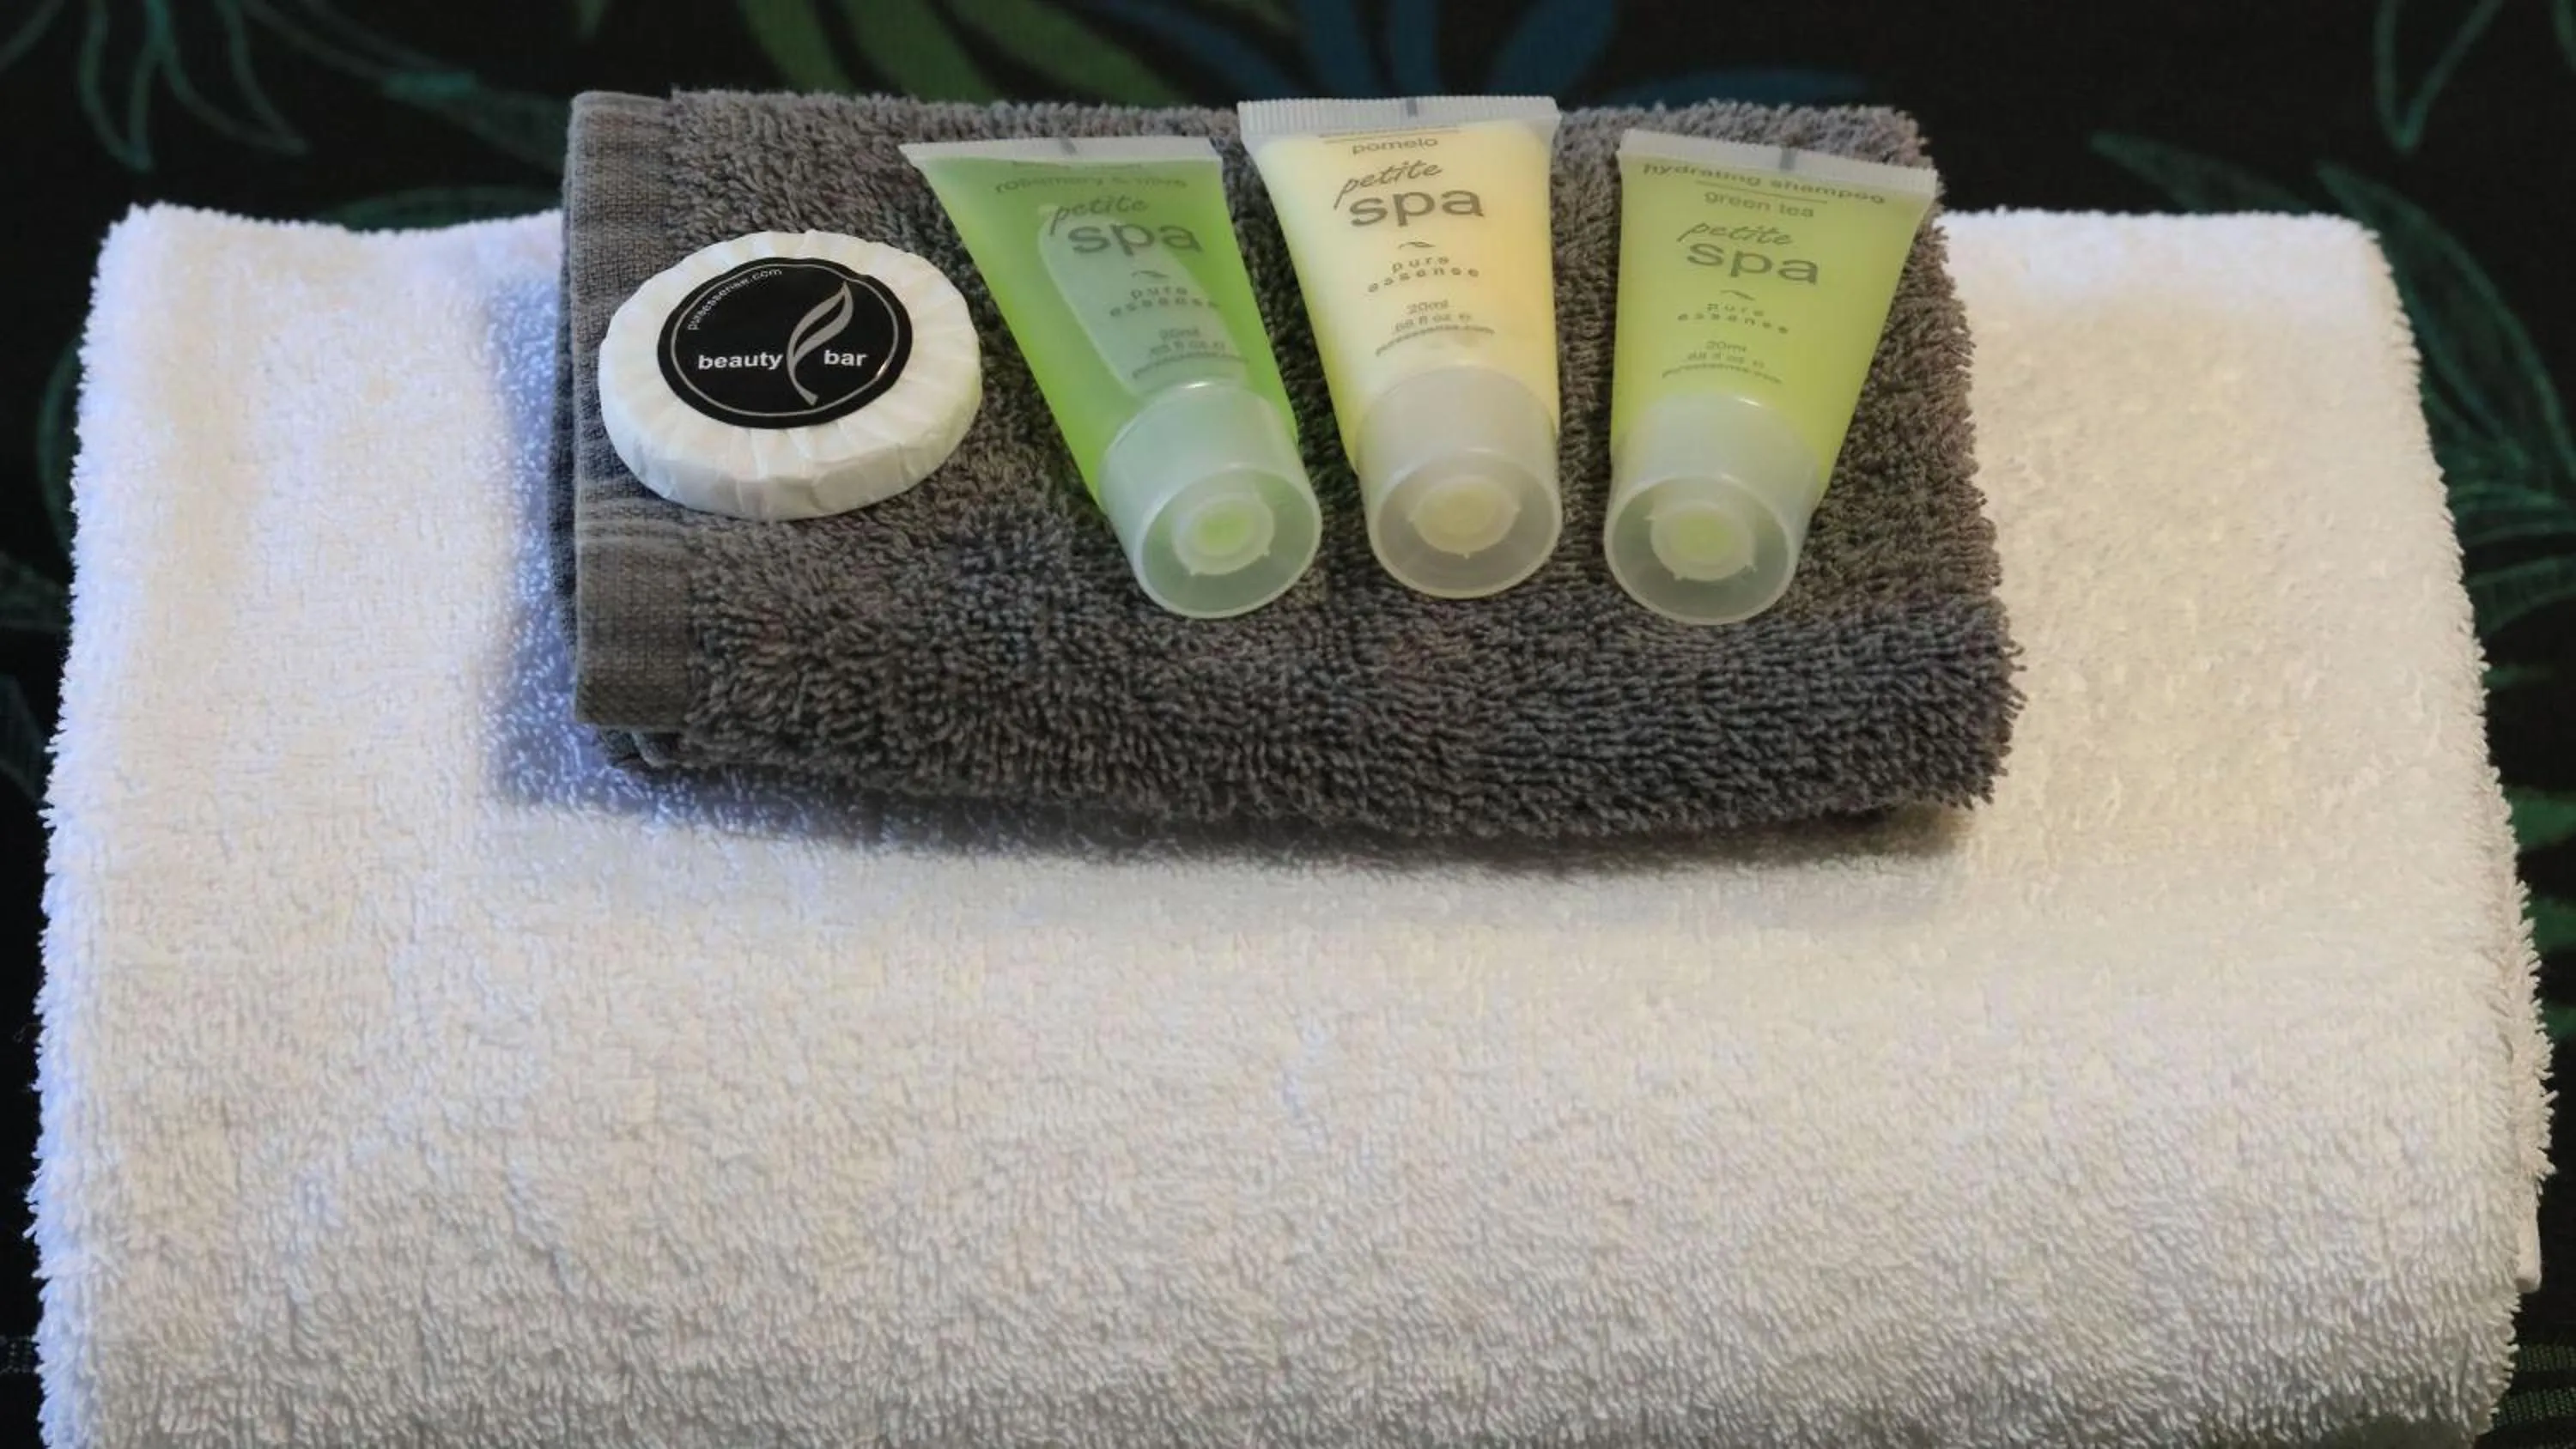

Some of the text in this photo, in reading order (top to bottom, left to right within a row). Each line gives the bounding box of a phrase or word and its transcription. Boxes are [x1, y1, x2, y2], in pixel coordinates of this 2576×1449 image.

[1352, 137, 1439, 155] pomelo
[1333, 159, 1444, 211] petite
[1643, 163, 1886, 204] hydrating shampoo
[1048, 193, 1149, 237] petite
[1348, 189, 1485, 227] spa
[1703, 191, 1815, 218] green tea
[1067, 222, 1205, 258] spa
[1675, 221, 1793, 246] petite
[1391, 256, 1450, 275] pure
[1686, 242, 1820, 286] spa
[698, 349, 868, 371] beauty bar
